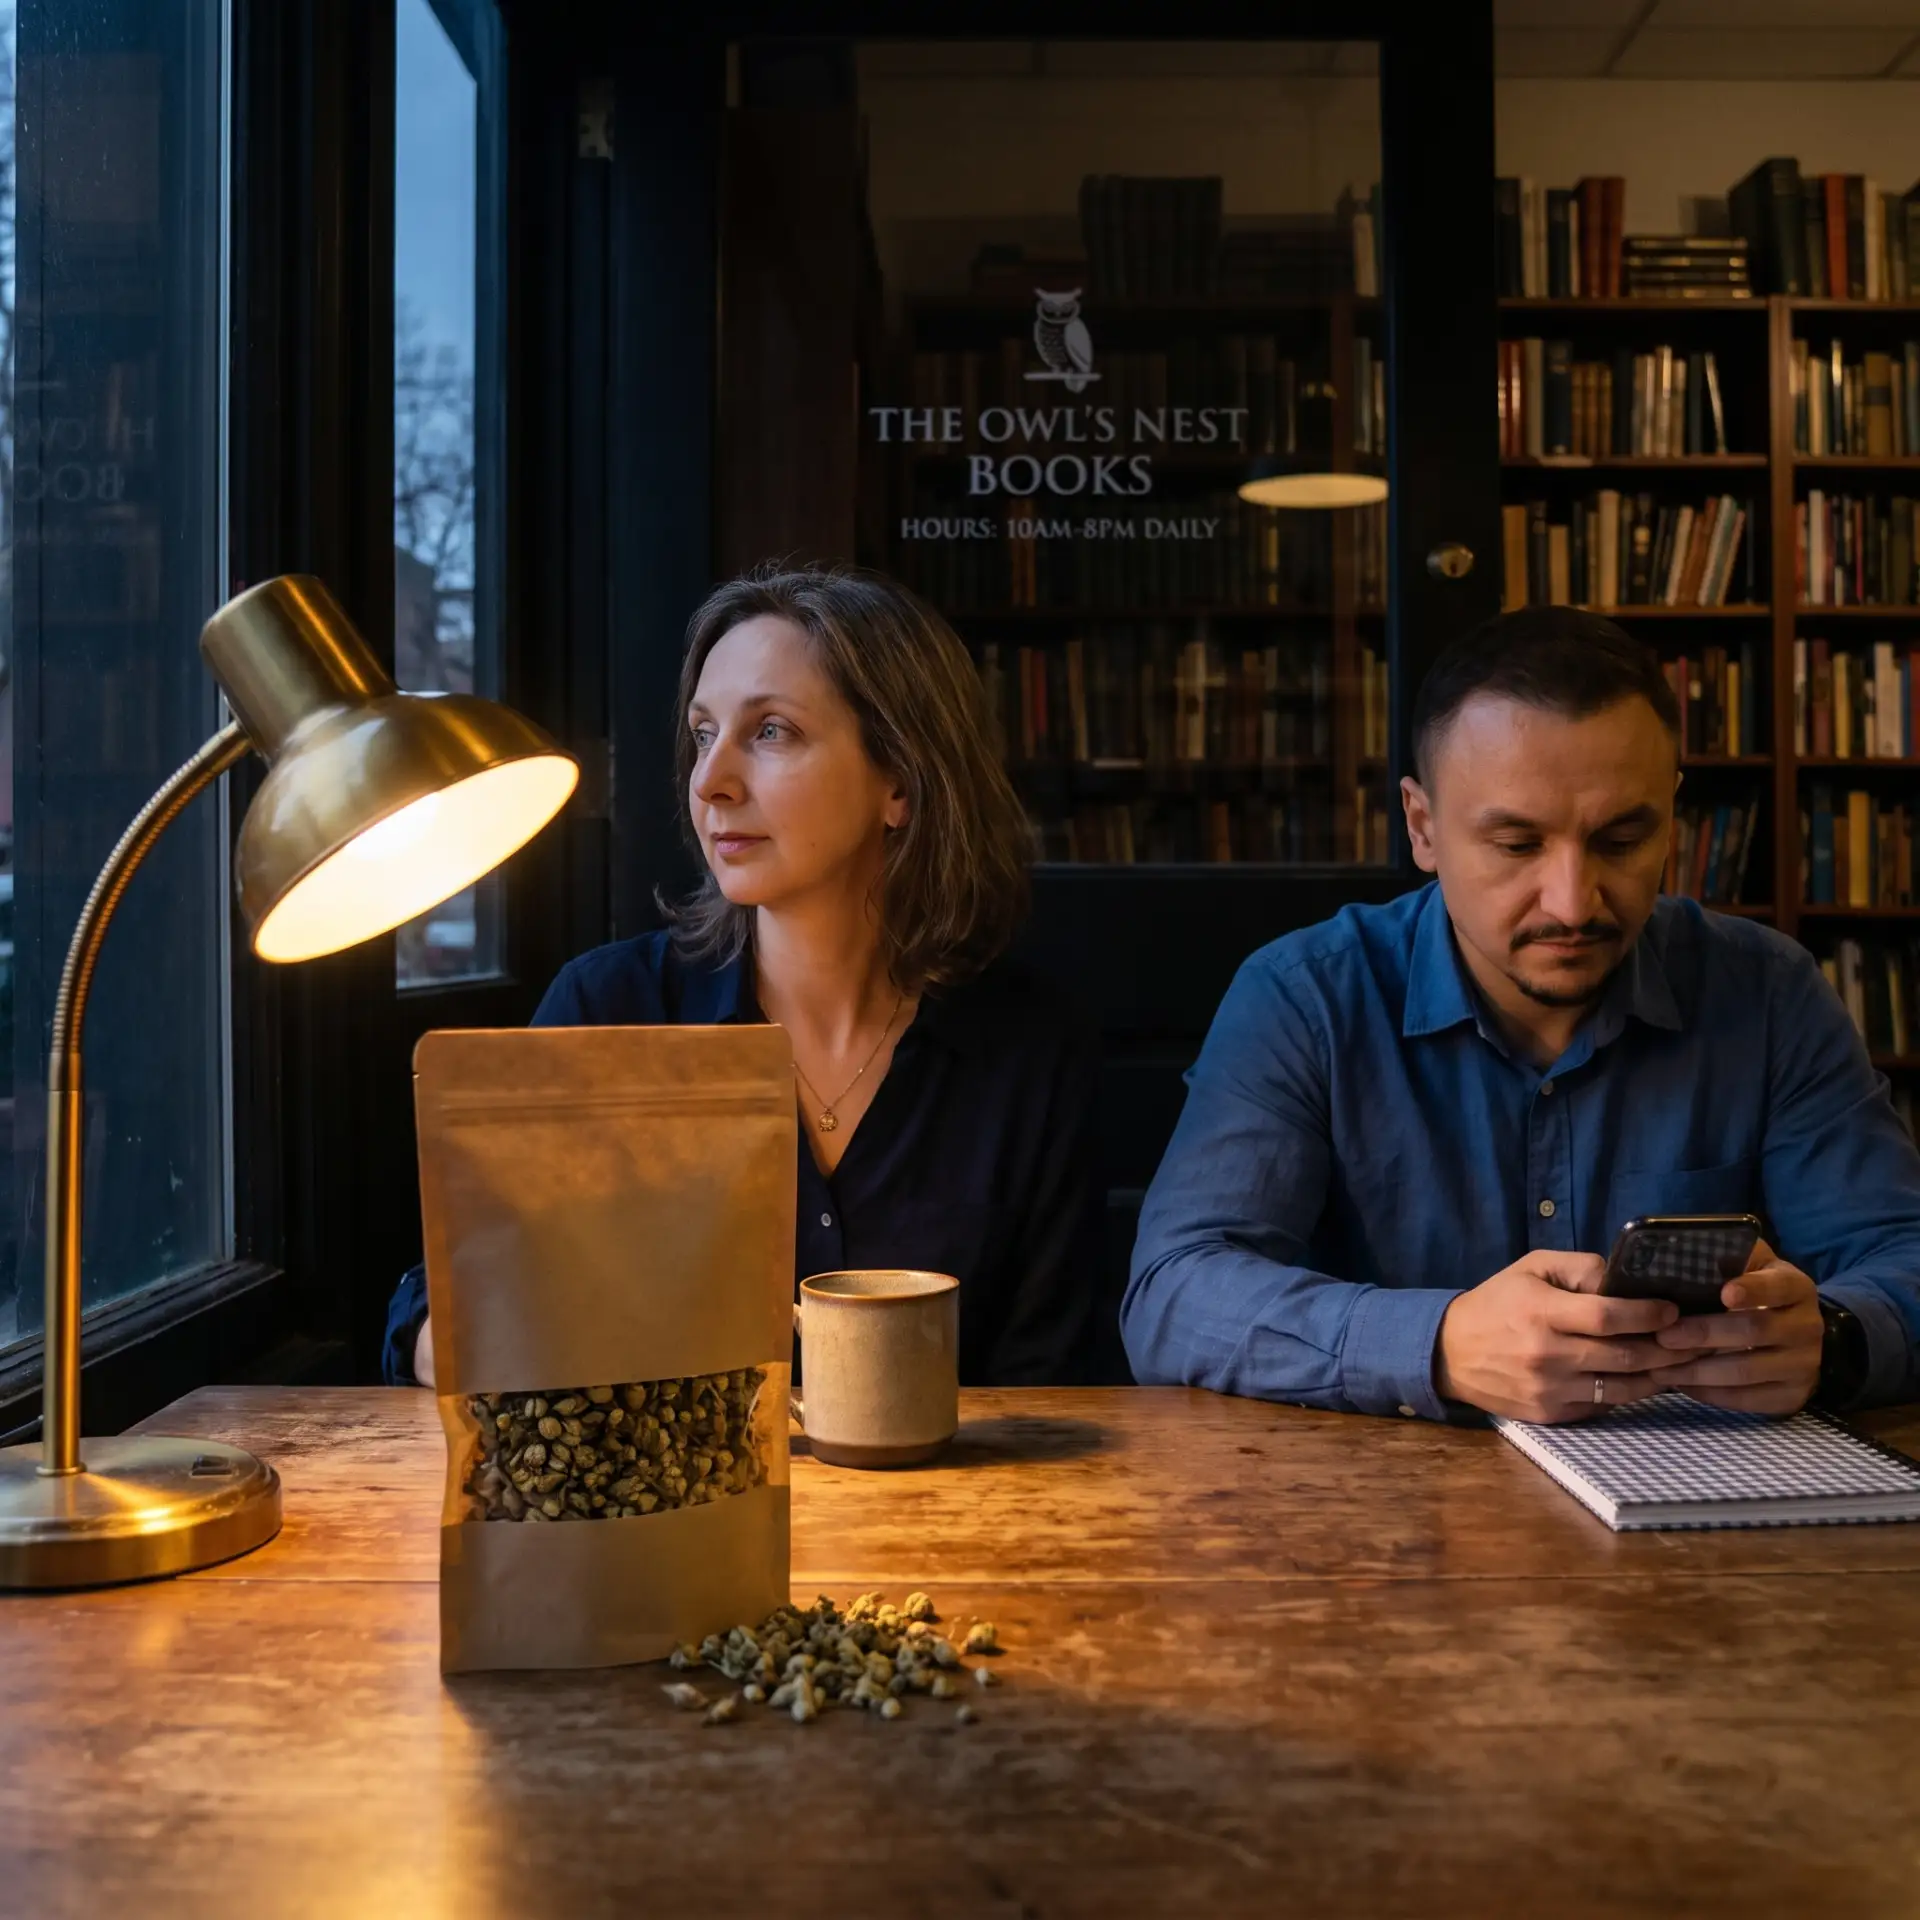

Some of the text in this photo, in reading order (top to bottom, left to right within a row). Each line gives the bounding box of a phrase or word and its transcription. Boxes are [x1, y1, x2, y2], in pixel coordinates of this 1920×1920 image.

[869, 406, 1249, 443] THE OWL'S NEST
[968, 455, 1153, 496] BOOKS
[900, 518, 1221, 540] HOURS: 10AM-8PM DAILY
